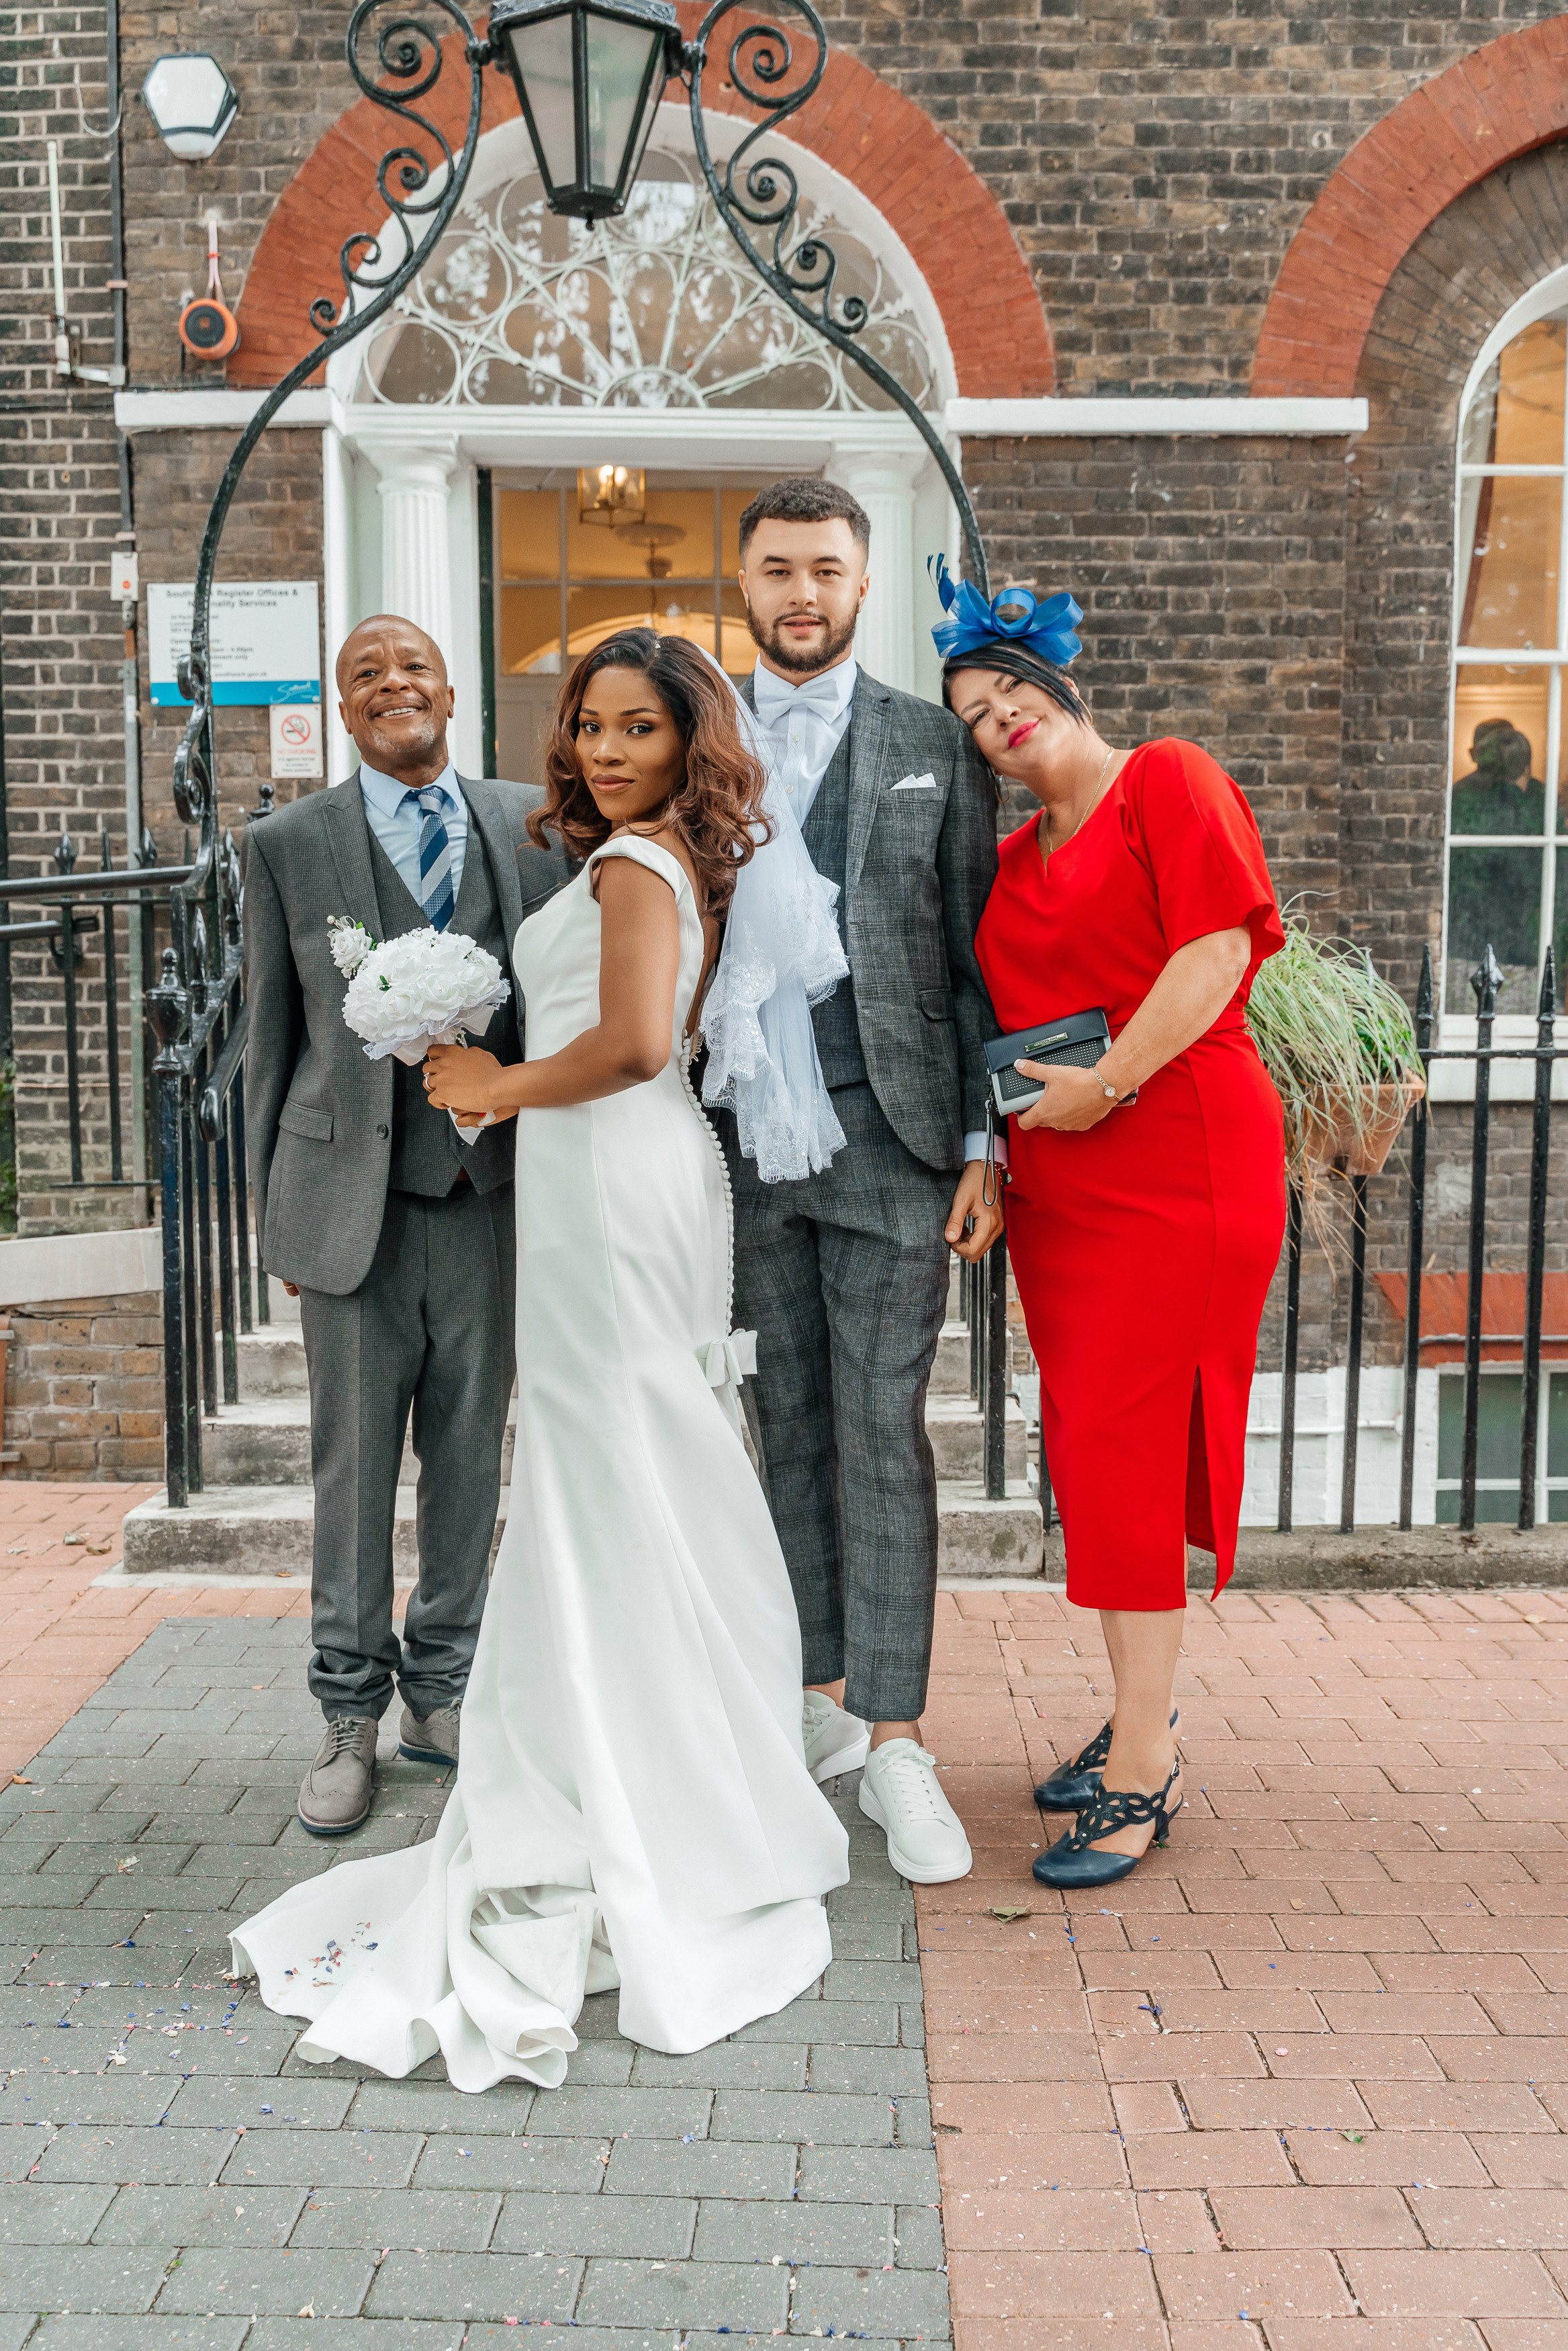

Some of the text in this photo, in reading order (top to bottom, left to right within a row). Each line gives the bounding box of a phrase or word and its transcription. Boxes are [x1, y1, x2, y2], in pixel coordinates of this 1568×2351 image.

[217, 589, 254, 598] Register
[257, 588, 289, 596] Offices
[292, 588, 298, 596] &
